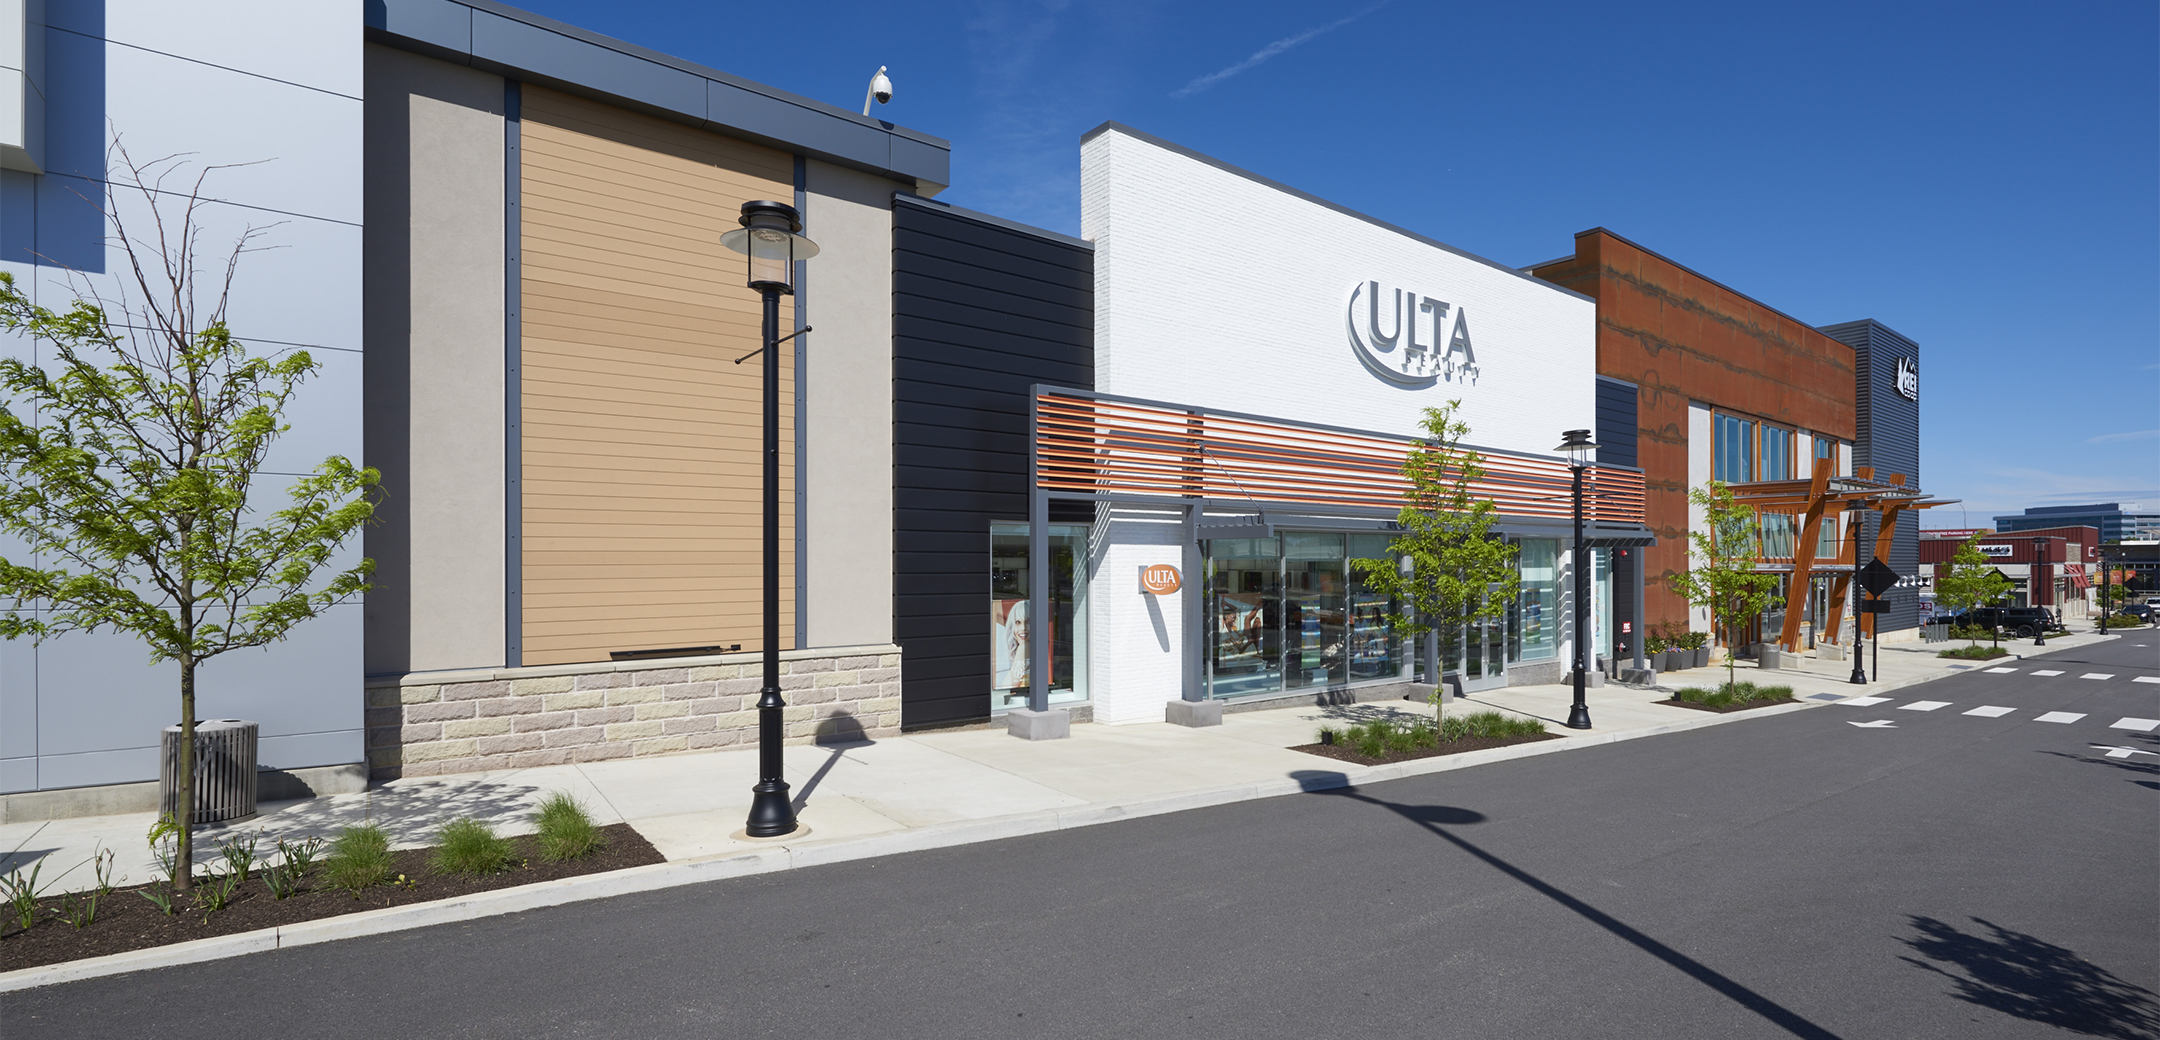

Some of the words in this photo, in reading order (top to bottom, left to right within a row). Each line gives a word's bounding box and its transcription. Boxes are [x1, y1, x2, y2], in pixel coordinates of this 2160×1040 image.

[1369, 280, 1476, 364] ULTA
[1405, 350, 1481, 379] BEAUTY
[1904, 371, 1917, 393] REI
[1148, 570, 1176, 584] ULTA
